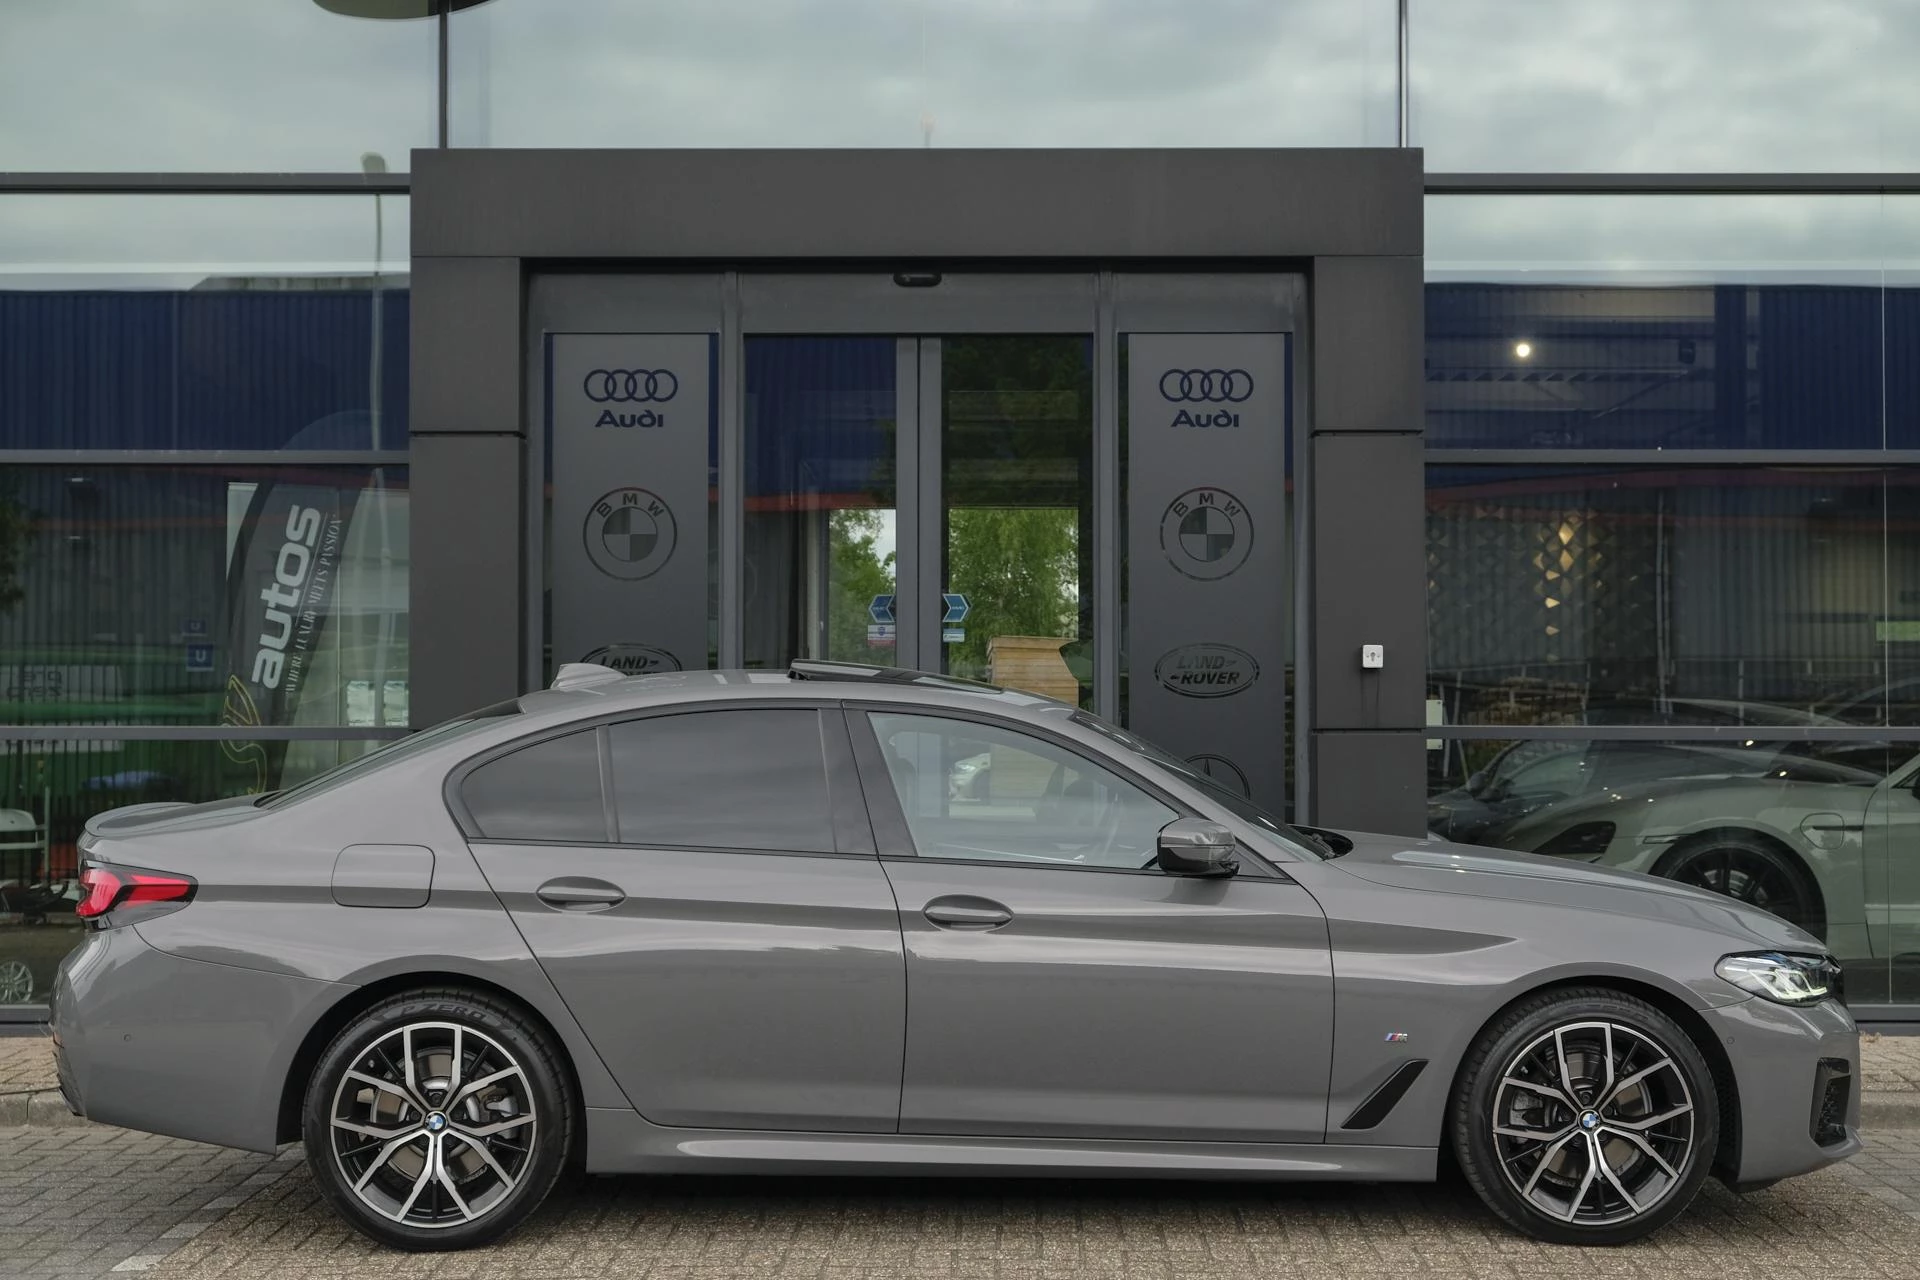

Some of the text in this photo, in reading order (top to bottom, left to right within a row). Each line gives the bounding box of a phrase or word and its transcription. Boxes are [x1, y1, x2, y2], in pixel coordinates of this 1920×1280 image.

[595, 409, 664, 428] Audi
[1171, 409, 1239, 428] Audi
[596, 493, 664, 518] BMW
[1173, 493, 1240, 518] BMW
[251, 504, 321, 689] autos
[308, 569, 328, 605] MEETS
[1180, 671, 1240, 685] ROVER
